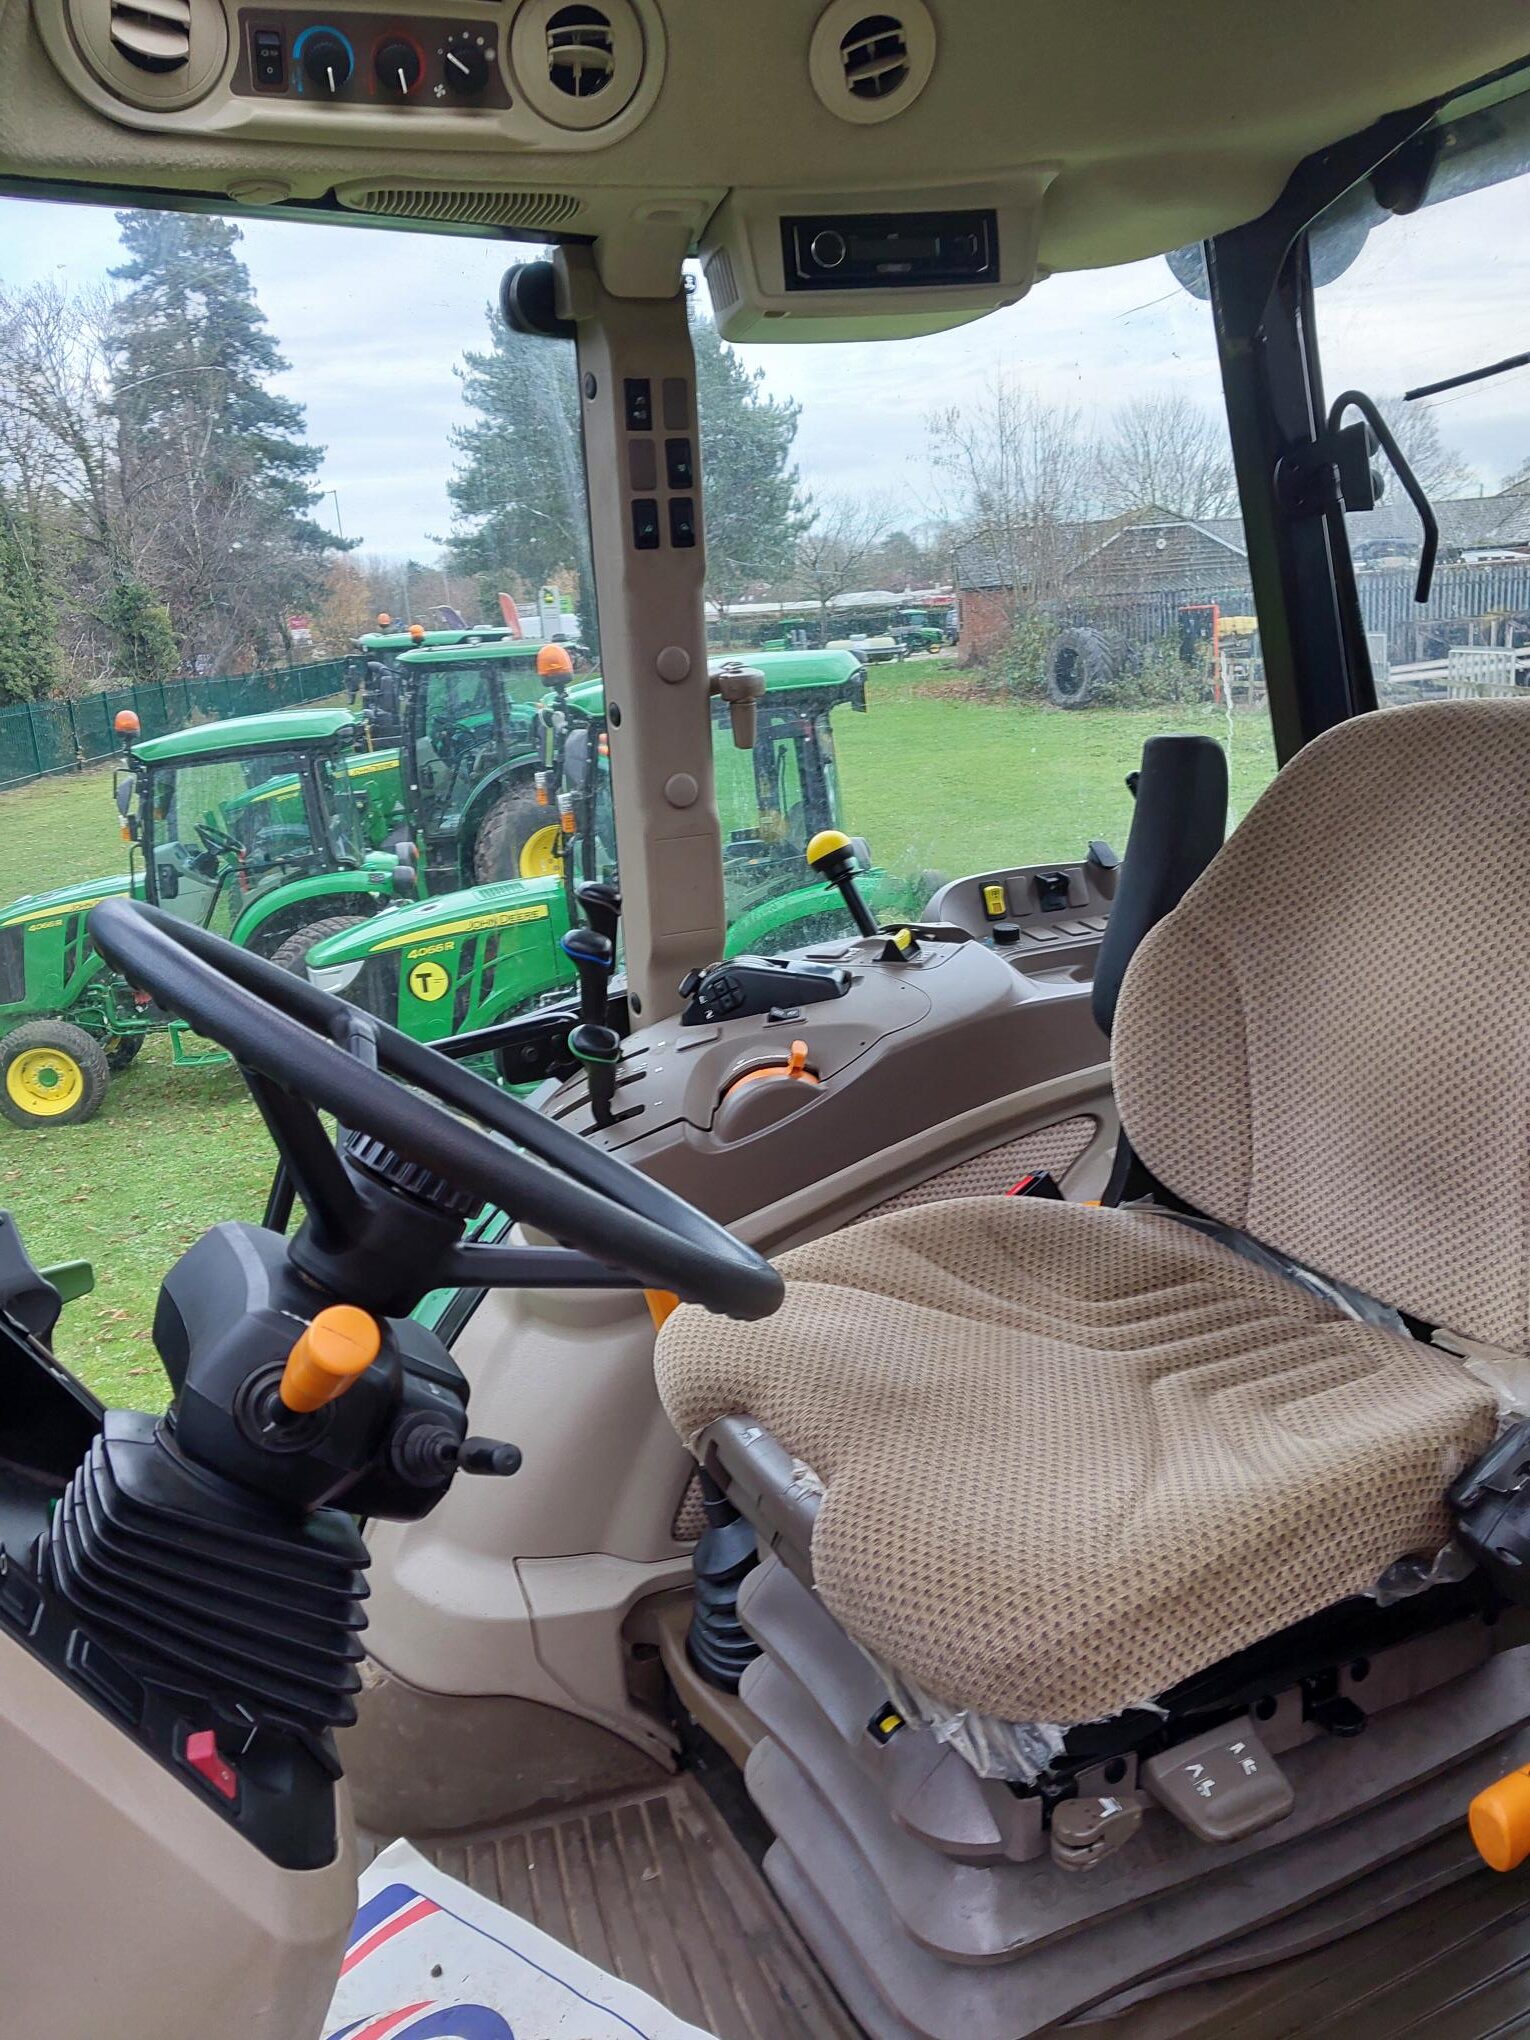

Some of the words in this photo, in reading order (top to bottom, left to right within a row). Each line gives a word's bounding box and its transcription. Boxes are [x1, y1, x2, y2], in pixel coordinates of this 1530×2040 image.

[467, 918, 497, 930] JOHN
[500, 910, 540, 925] DEERE
[415, 972, 433, 994] T
